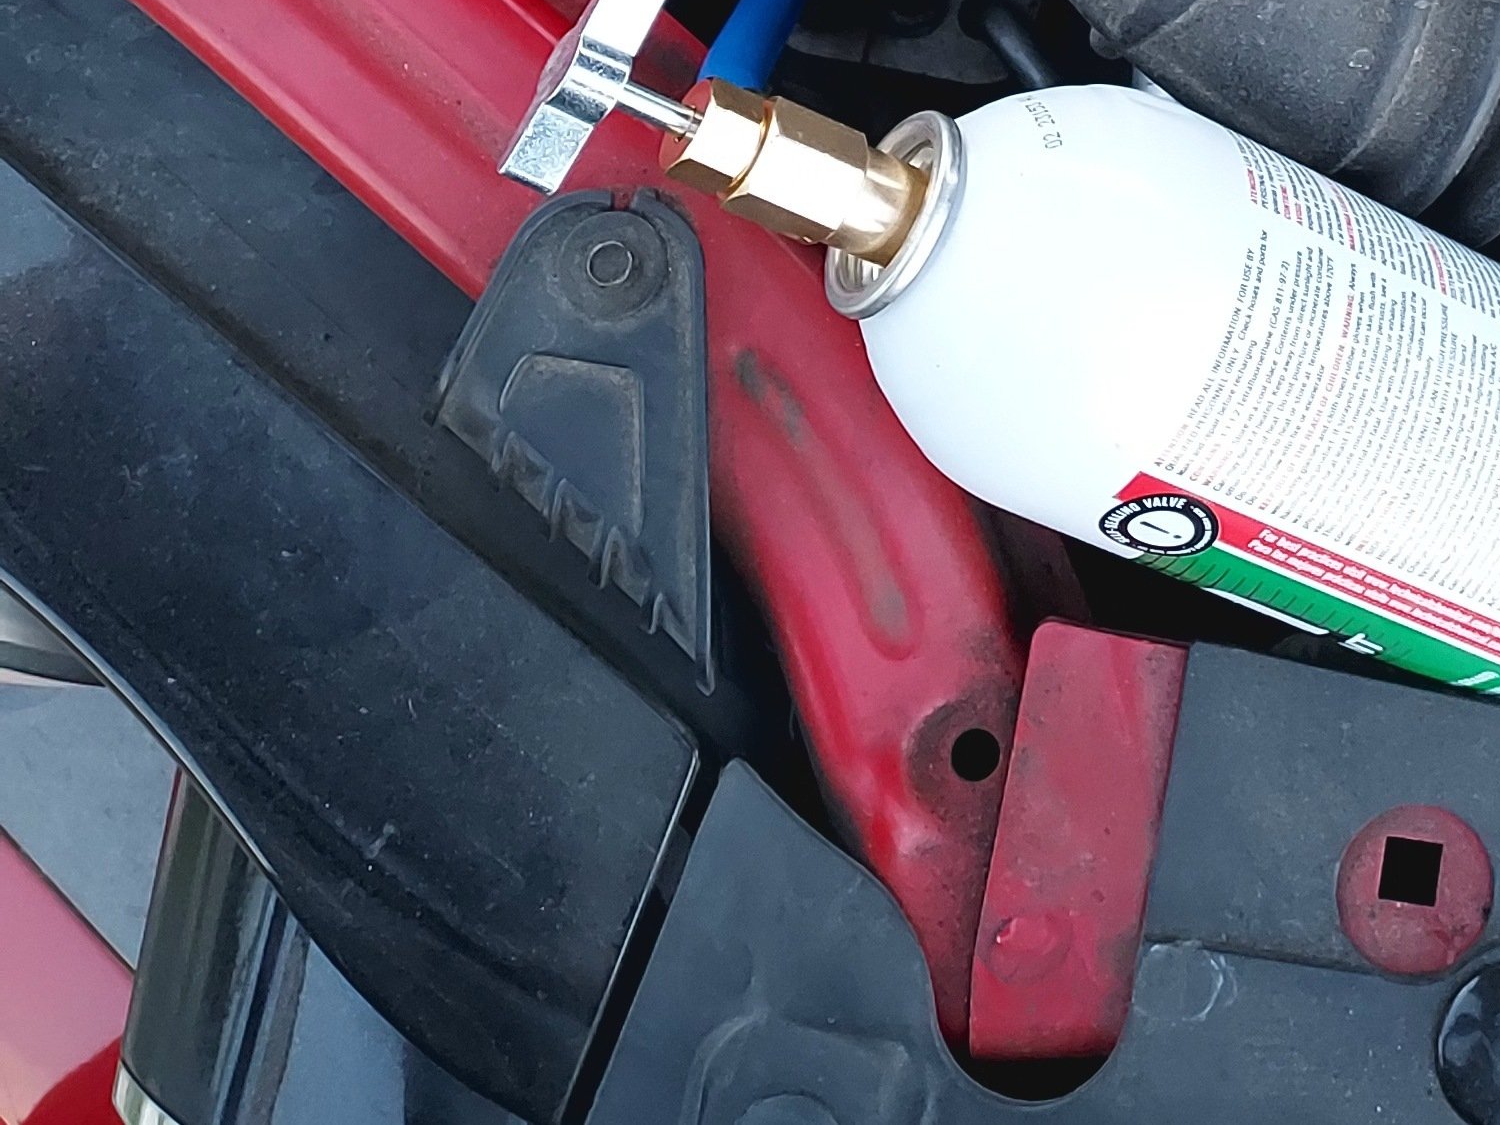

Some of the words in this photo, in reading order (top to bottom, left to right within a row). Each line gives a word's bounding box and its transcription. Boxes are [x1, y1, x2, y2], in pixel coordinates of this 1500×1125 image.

[1256, 241, 1268, 267] ports
[1240, 260, 1253, 283] USE
[1252, 264, 1264, 284] and
[1301, 262, 1314, 298] sunlight
[1235, 281, 1249, 304] FOR
[1246, 283, 1260, 312] hoses
[1286, 287, 1298, 315] under
[1294, 297, 1308, 325] direct
[1306, 307, 1330, 368] temperatures
[1321, 280, 1333, 308] above
[1437, 301, 1448, 349] PRESSURE
[1209, 305, 1243, 374] INFORMATION
[1235, 311, 1253, 341] Check
[1288, 324, 1302, 348] from
[1342, 344, 1357, 376] rubber
[1351, 314, 1364, 345] gloves
[1280, 348, 1296, 374] away
[1368, 343, 1393, 405] concentrating
[1215, 387, 1237, 417] before
[1142, 496, 1188, 510] VALVE
